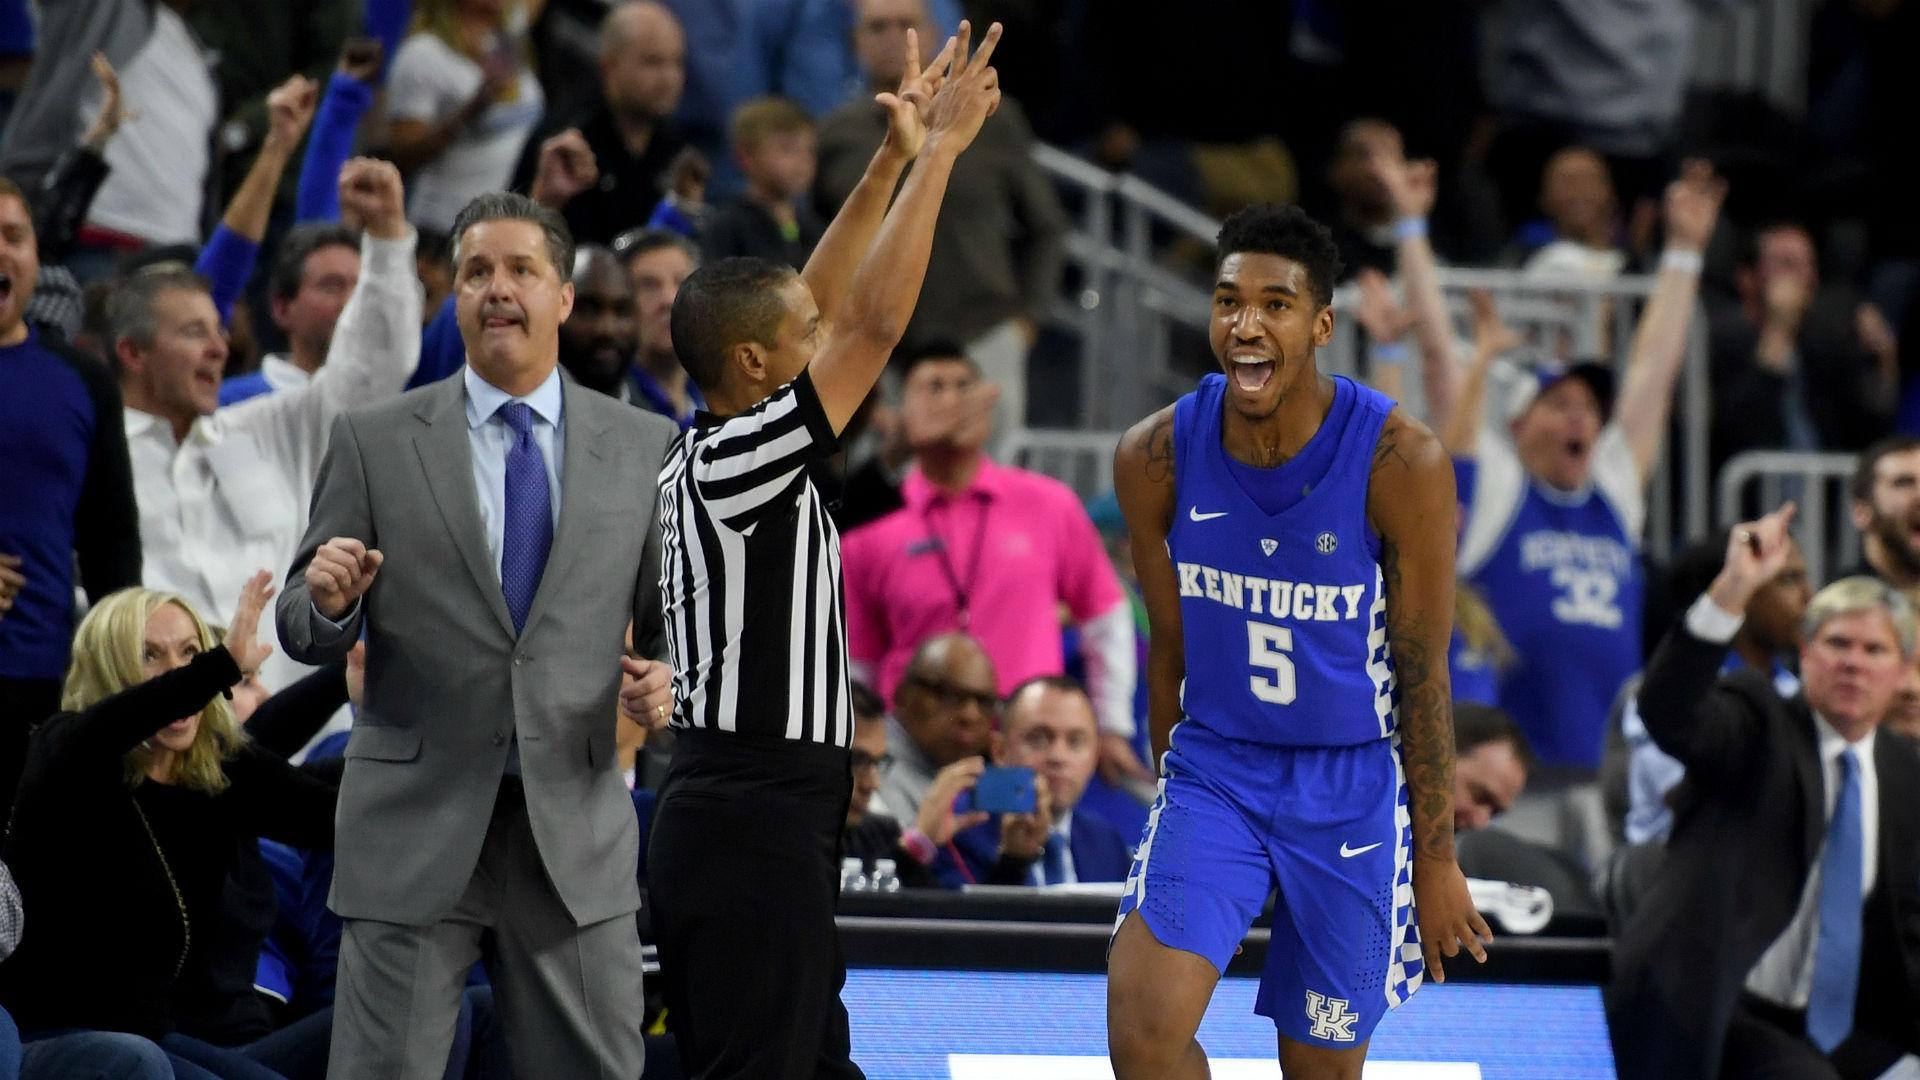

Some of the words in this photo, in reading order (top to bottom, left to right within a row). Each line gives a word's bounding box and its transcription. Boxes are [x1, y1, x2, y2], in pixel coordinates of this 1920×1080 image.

[1317, 533, 1336, 553] SEC
[1177, 561, 1365, 621] KENTUCKY
[1246, 620, 1296, 706] 5
[1306, 989, 1358, 1041] UK
